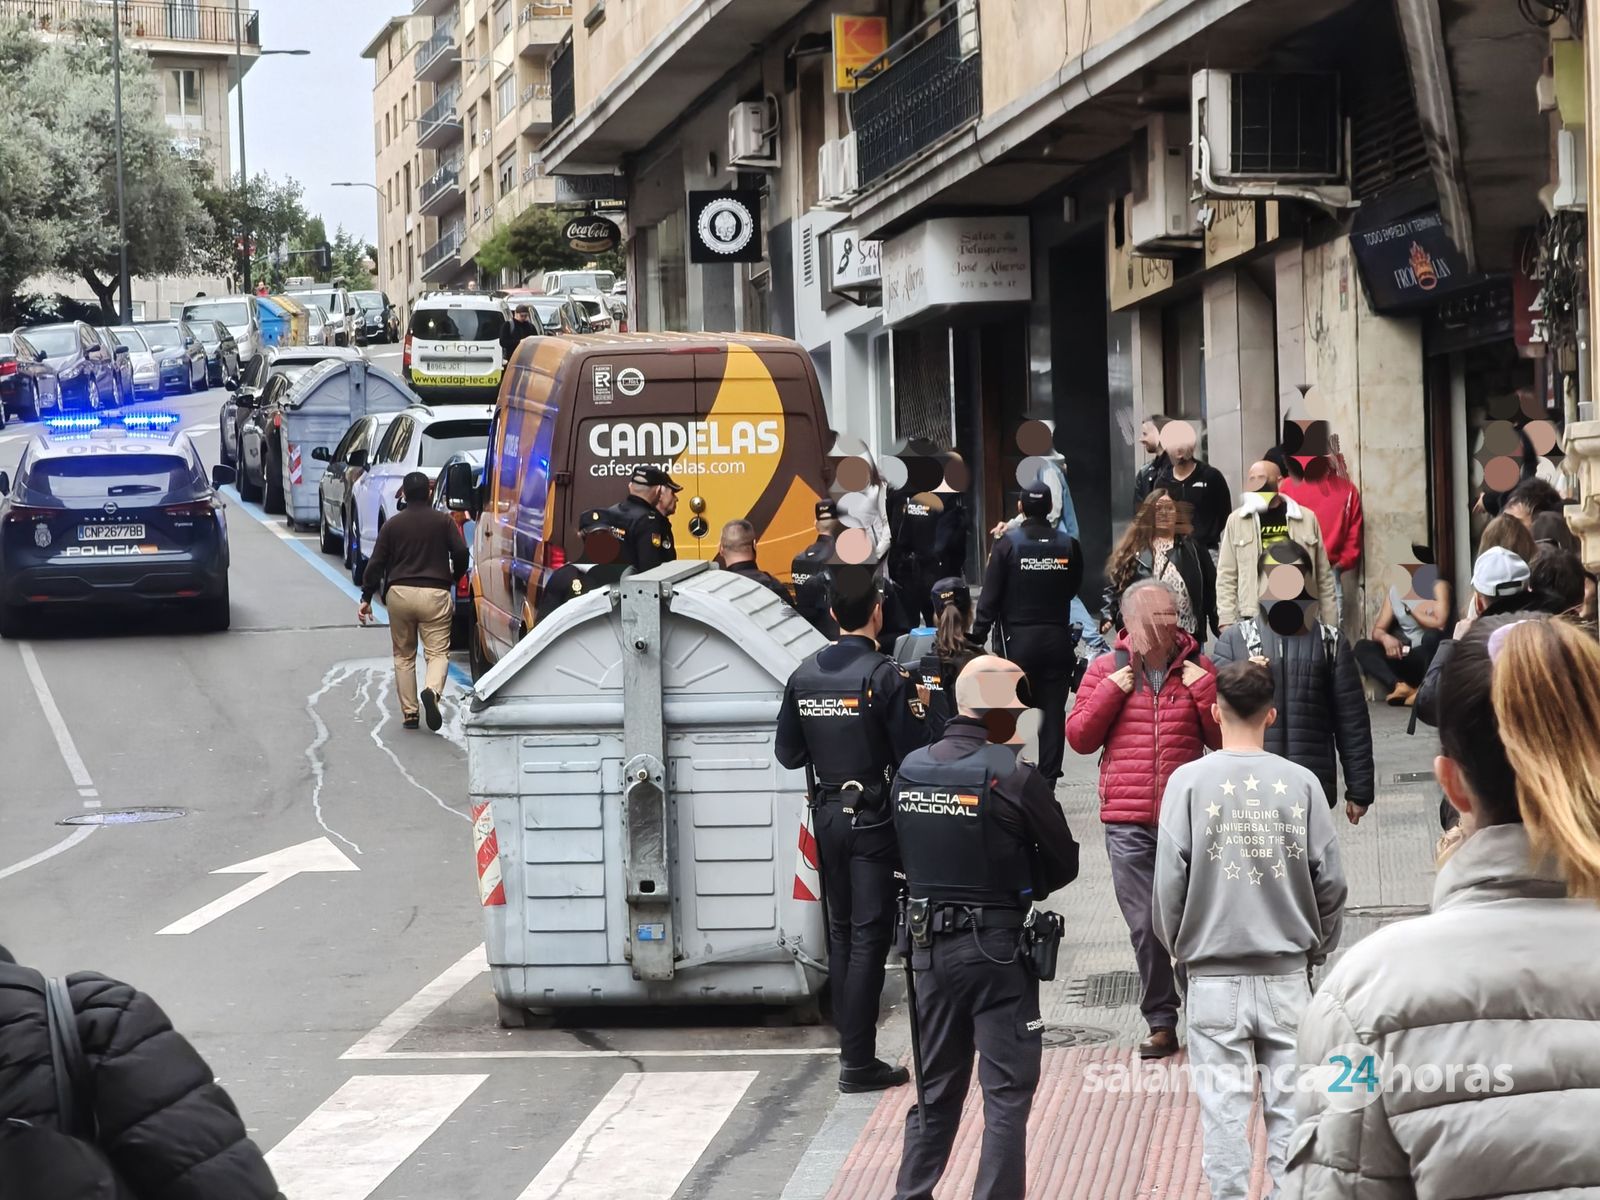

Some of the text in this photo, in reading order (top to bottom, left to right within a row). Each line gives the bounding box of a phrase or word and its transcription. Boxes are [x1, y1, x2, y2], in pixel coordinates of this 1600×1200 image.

[589, 420, 780, 457] CANDELAS
[67, 544, 142, 556] POLICIA
[1020, 563, 1069, 571] NACIONAL
[798, 699, 844, 708] POLICIA
[799, 707, 859, 716] NACIONAL
[899, 791, 961, 805] POLICIA
[899, 802, 977, 817] NACIONAL
[1232, 809, 1279, 820] BUILDING
[1205, 822, 1306, 836] A UNIVERSAL TREND
[1225, 836, 1285, 845] ACROSS THE
[1240, 848, 1273, 858] GLOBE
